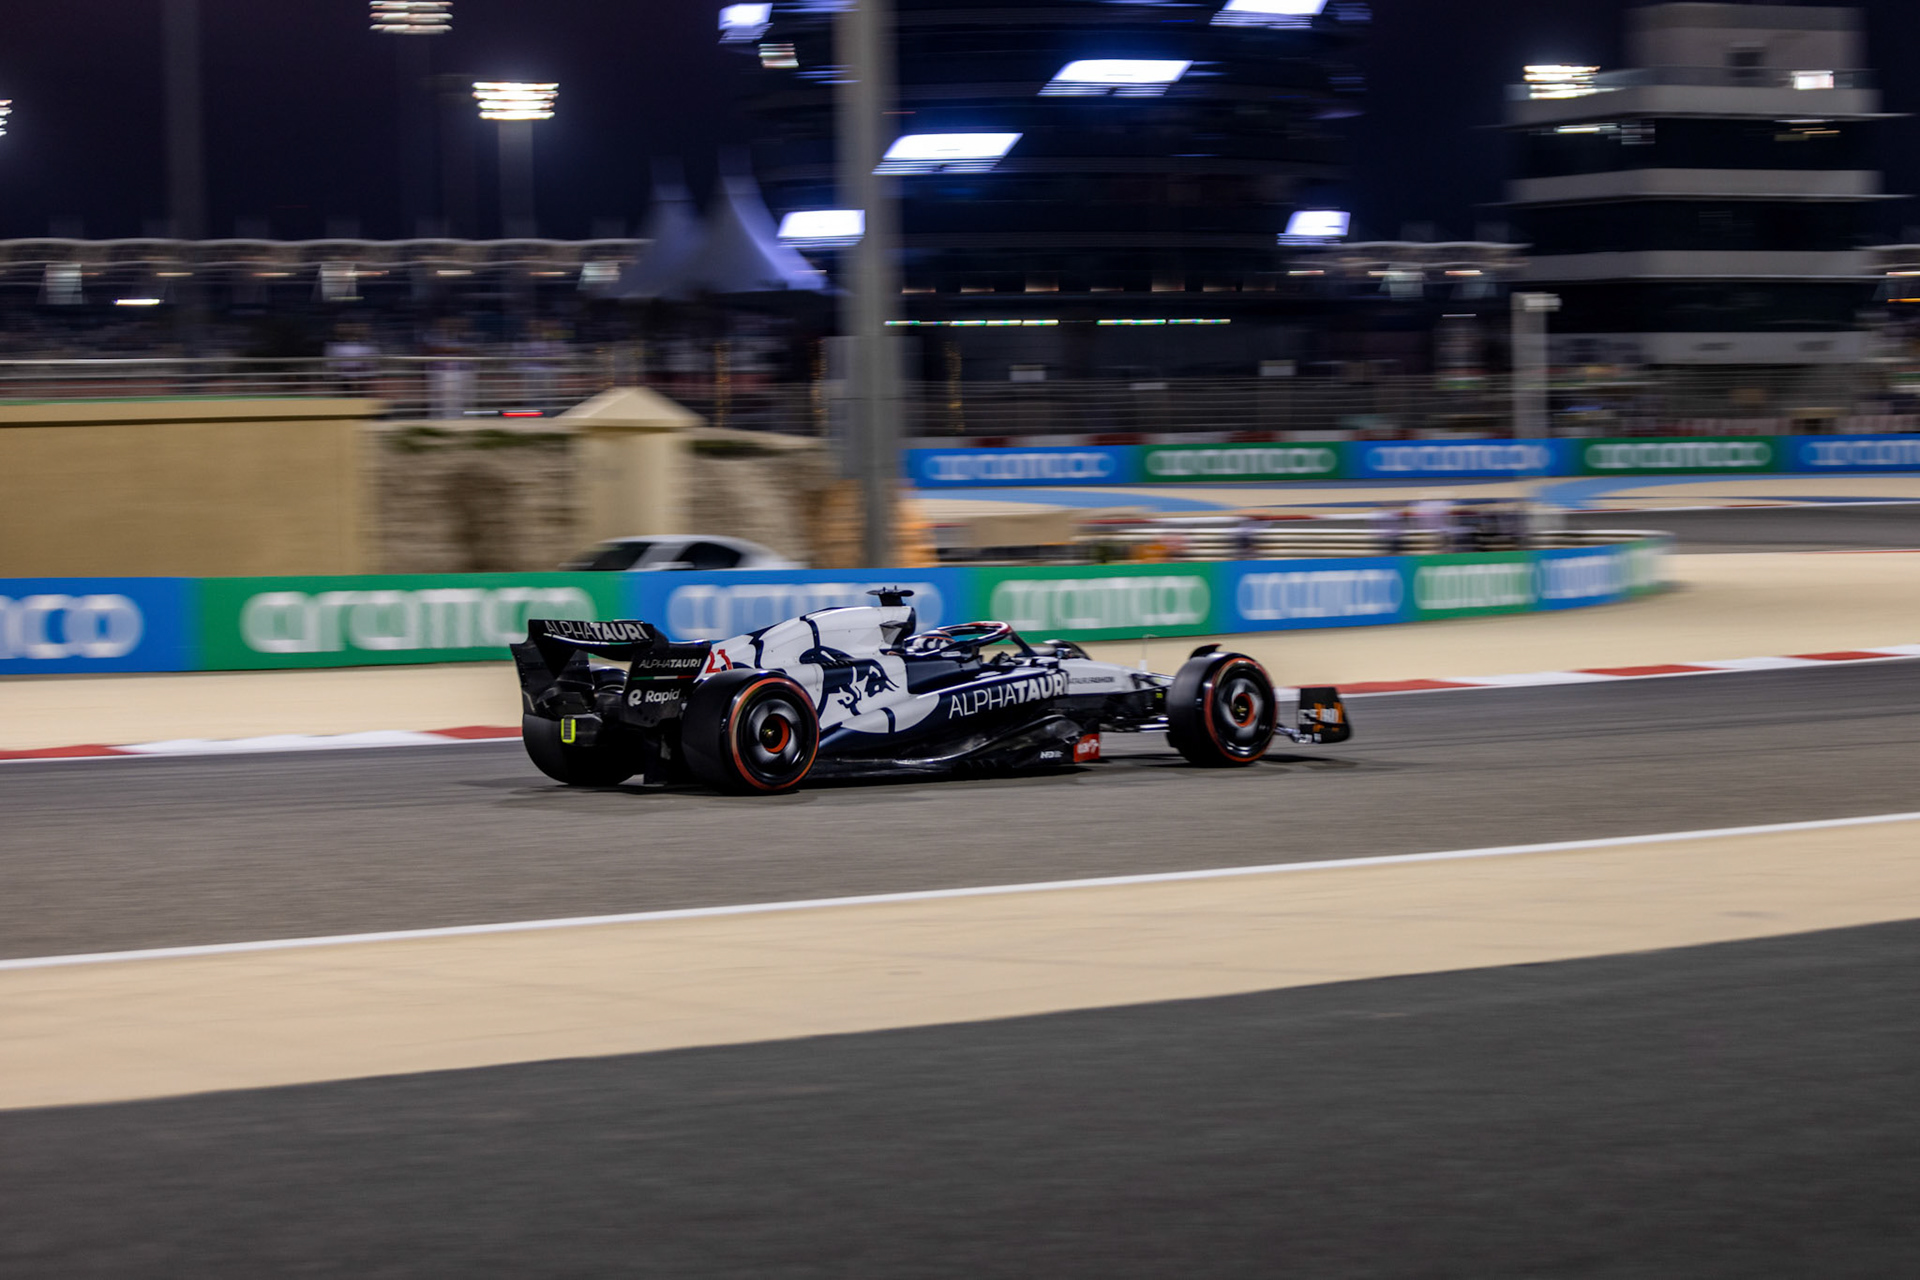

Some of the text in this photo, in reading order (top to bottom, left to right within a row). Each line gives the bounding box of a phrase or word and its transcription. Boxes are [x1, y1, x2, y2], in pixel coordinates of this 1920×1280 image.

[544, 620, 650, 641] ALPHATAURI
[638, 658, 702, 669] ALPHATAURI
[645, 689, 681, 704] Rapid
[948, 671, 1069, 719] ALPHATAURI
